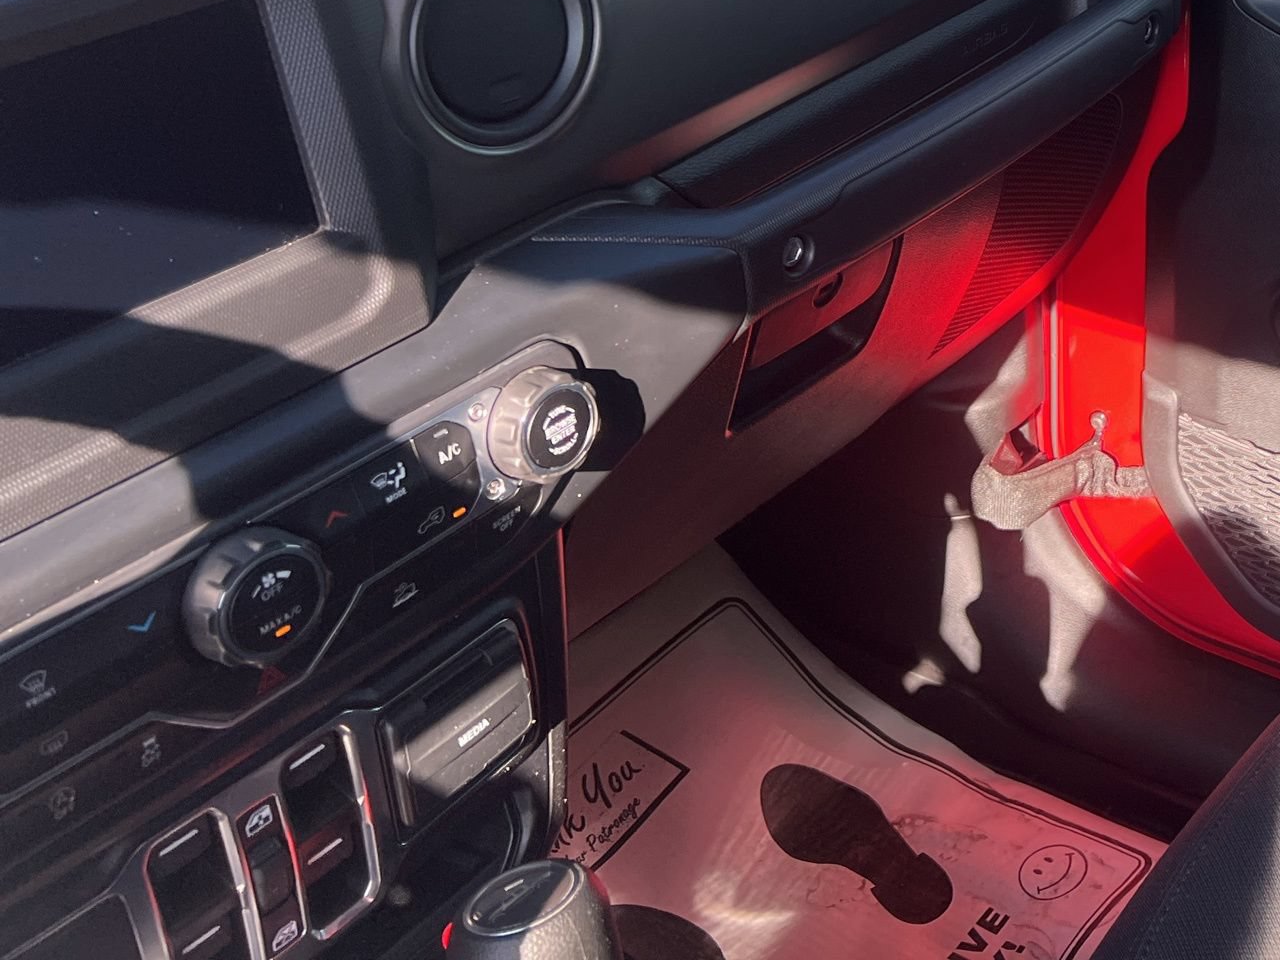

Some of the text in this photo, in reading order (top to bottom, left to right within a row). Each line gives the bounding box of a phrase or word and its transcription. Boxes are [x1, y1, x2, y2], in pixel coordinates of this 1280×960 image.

[551, 424, 576, 445] ENTER
[438, 442, 461, 465] A/C
[384, 486, 408, 505] MODE
[492, 505, 521, 529] SCREEN
[499, 518, 514, 532] OFF
[260, 581, 284, 601] OFF
[257, 604, 302, 636] MAX A/C
[456, 717, 491, 749] MEDIA
[581, 760, 643, 809] You
[585, 796, 642, 853] Patronage
